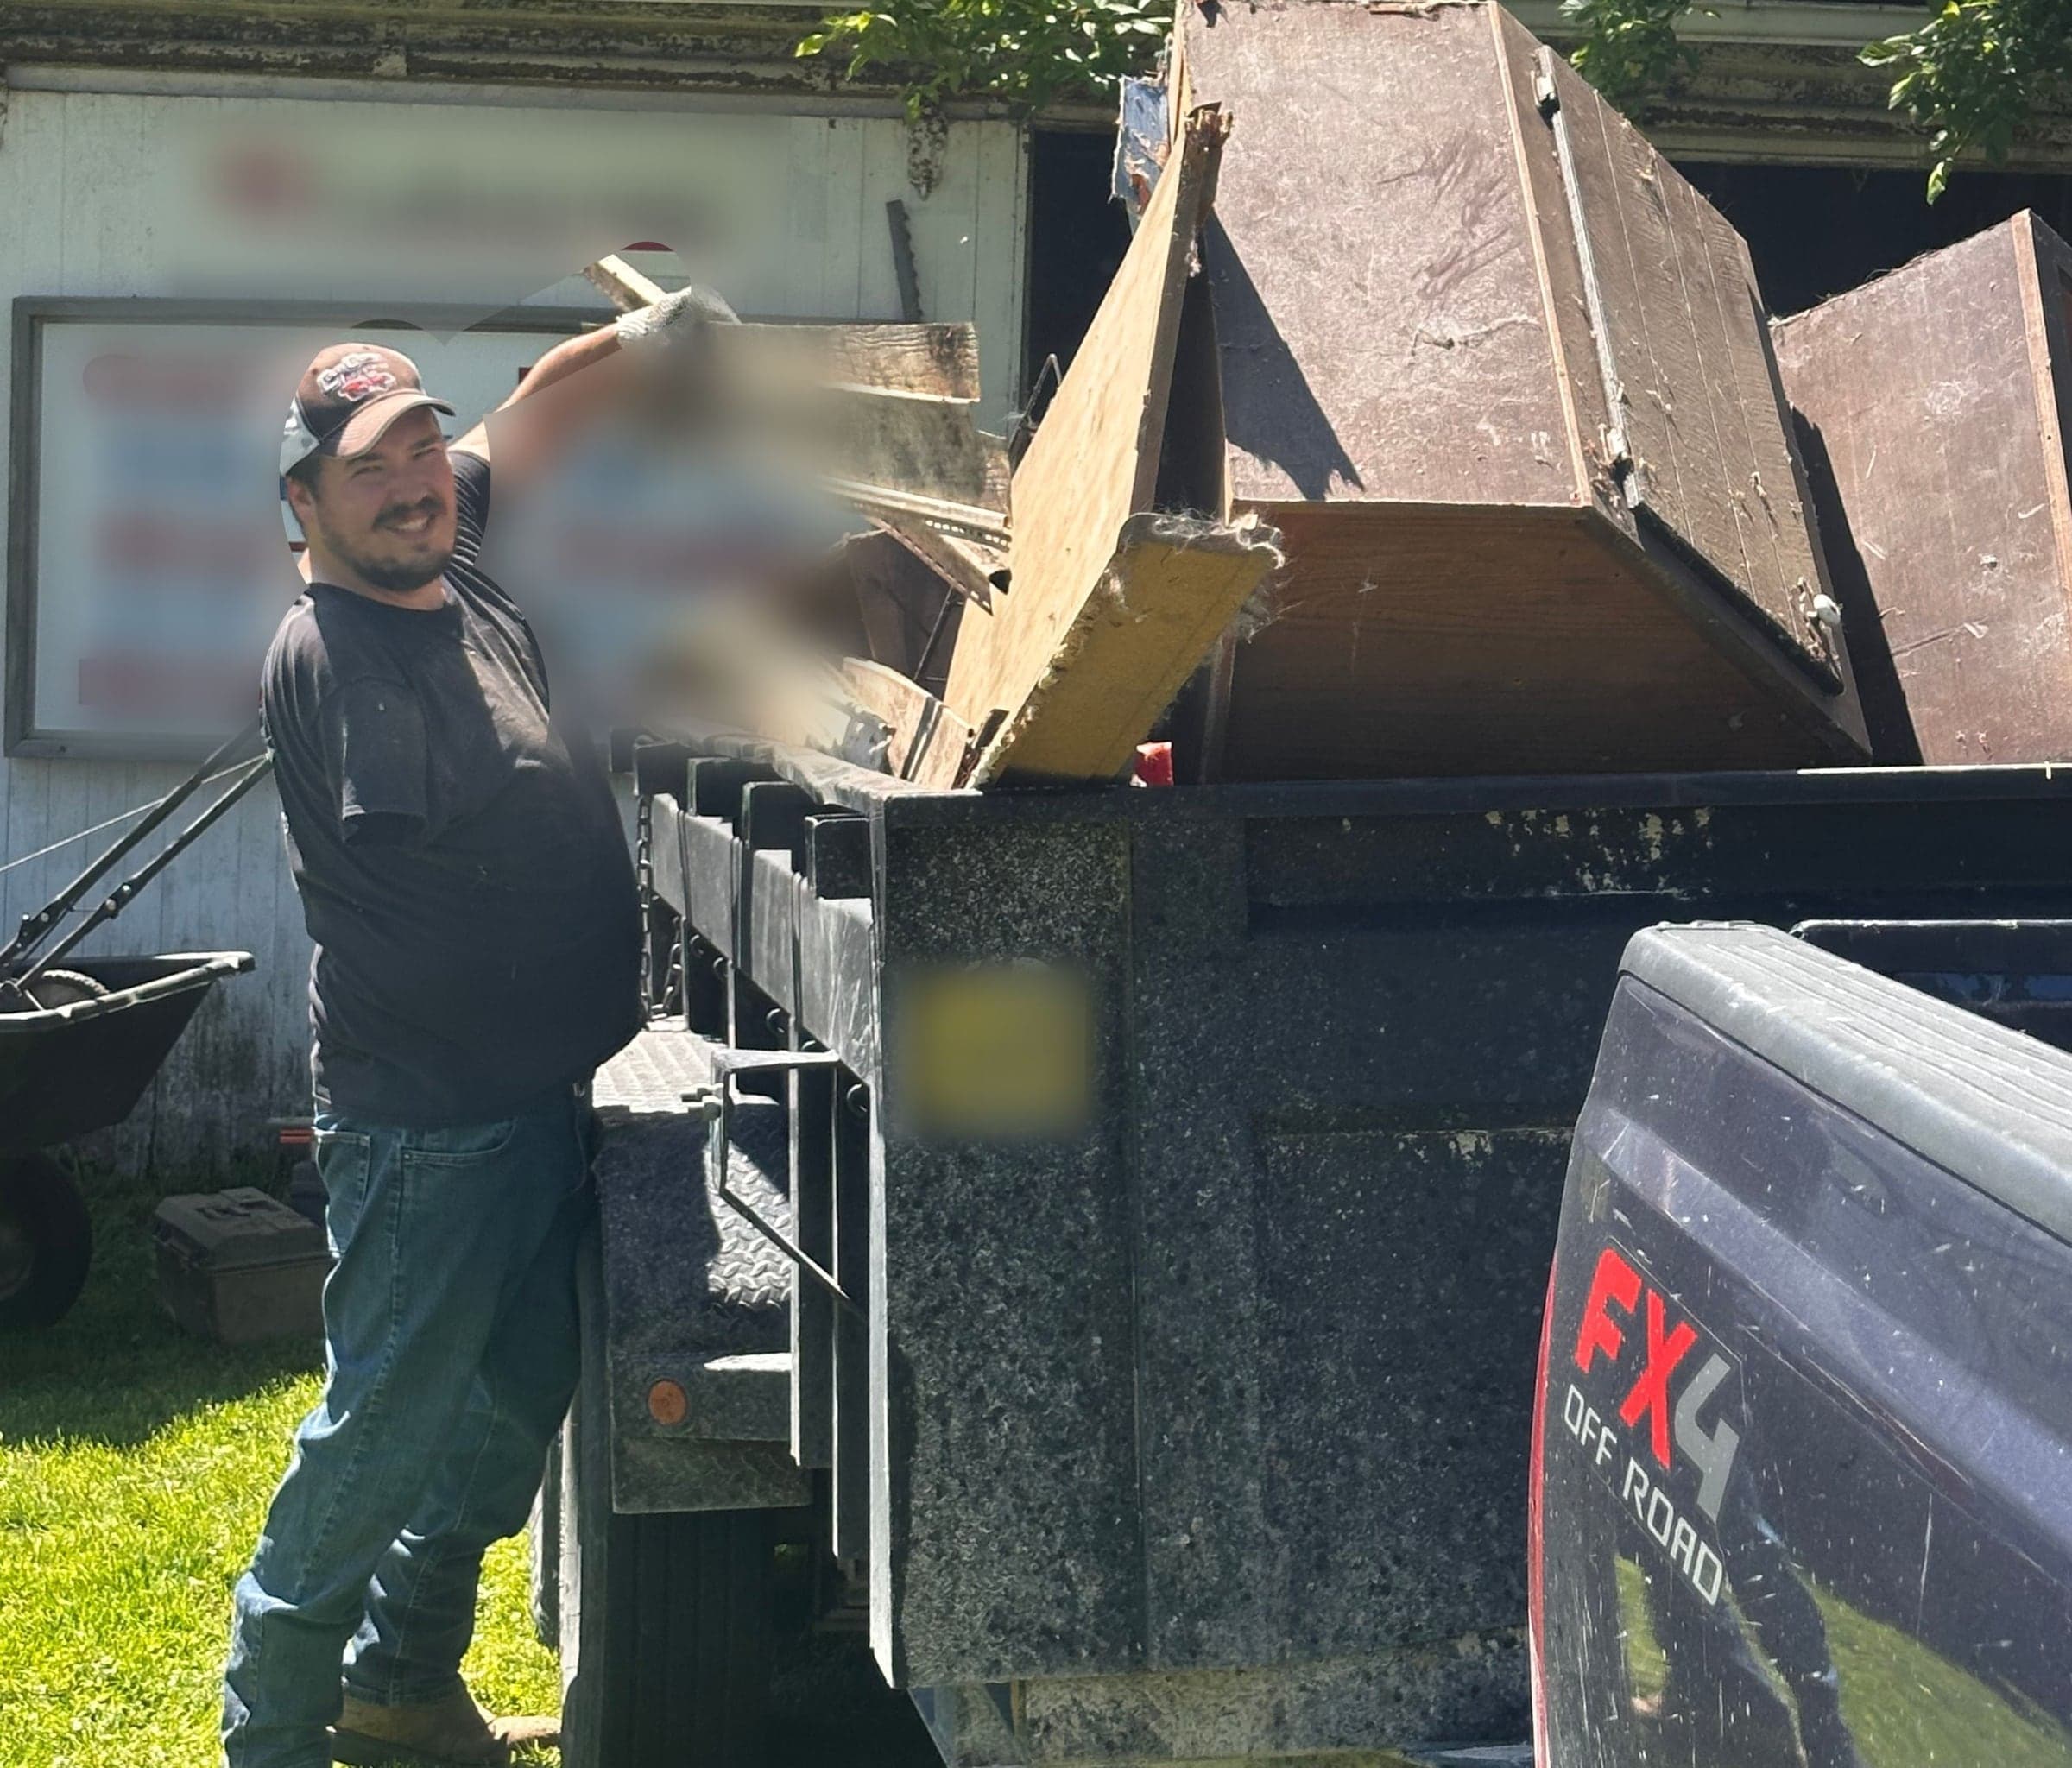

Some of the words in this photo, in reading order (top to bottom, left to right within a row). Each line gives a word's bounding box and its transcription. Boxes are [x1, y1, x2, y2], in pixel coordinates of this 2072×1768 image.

[1564, 1384, 1618, 1465] OFF
[1622, 1457, 1723, 1606] ROAD
[1576, 1248, 1740, 1523] FX4
